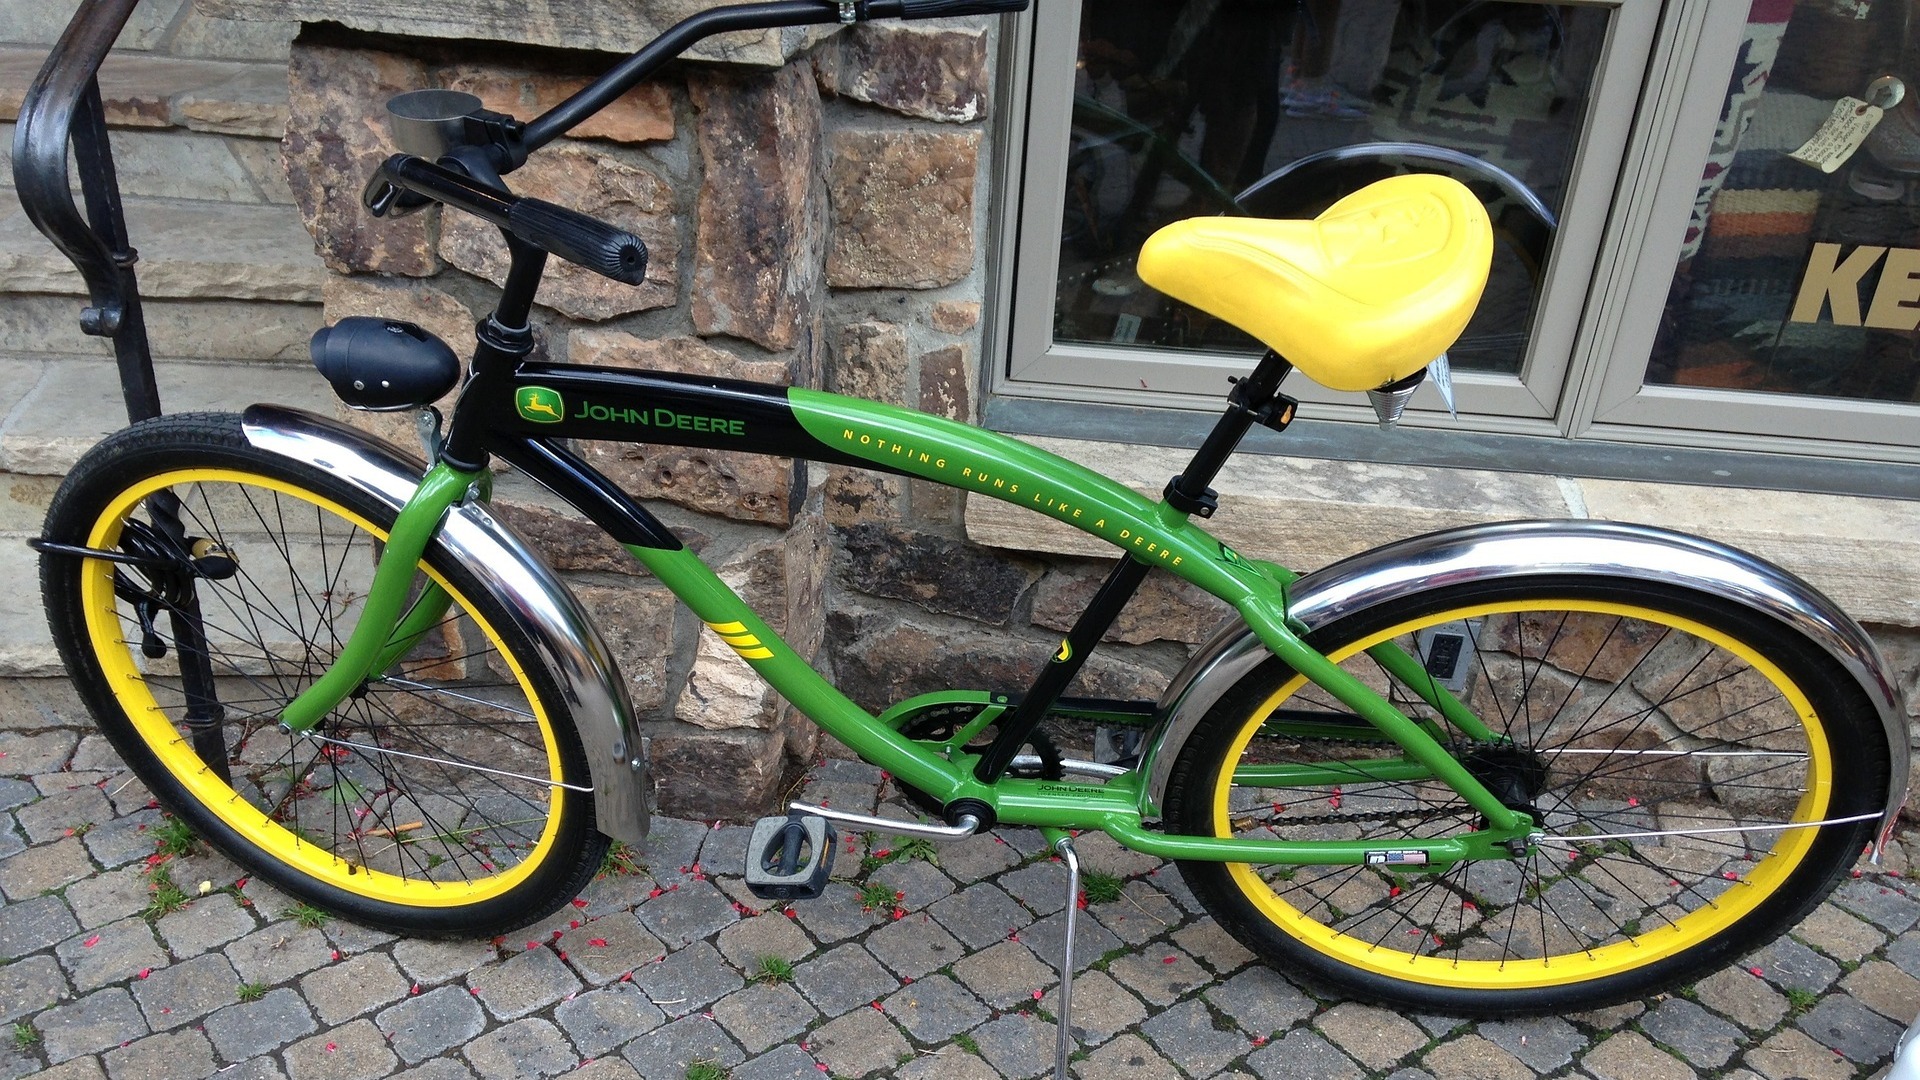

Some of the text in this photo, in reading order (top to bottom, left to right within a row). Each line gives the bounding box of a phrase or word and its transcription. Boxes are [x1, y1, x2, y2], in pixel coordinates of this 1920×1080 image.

[1789, 242, 1920, 331] KE
[654, 408, 746, 436] DEERE
[843, 429, 1183, 566] NOTHING RUNS LIKE A DEERE
[1037, 784, 1067, 792] JOHN
